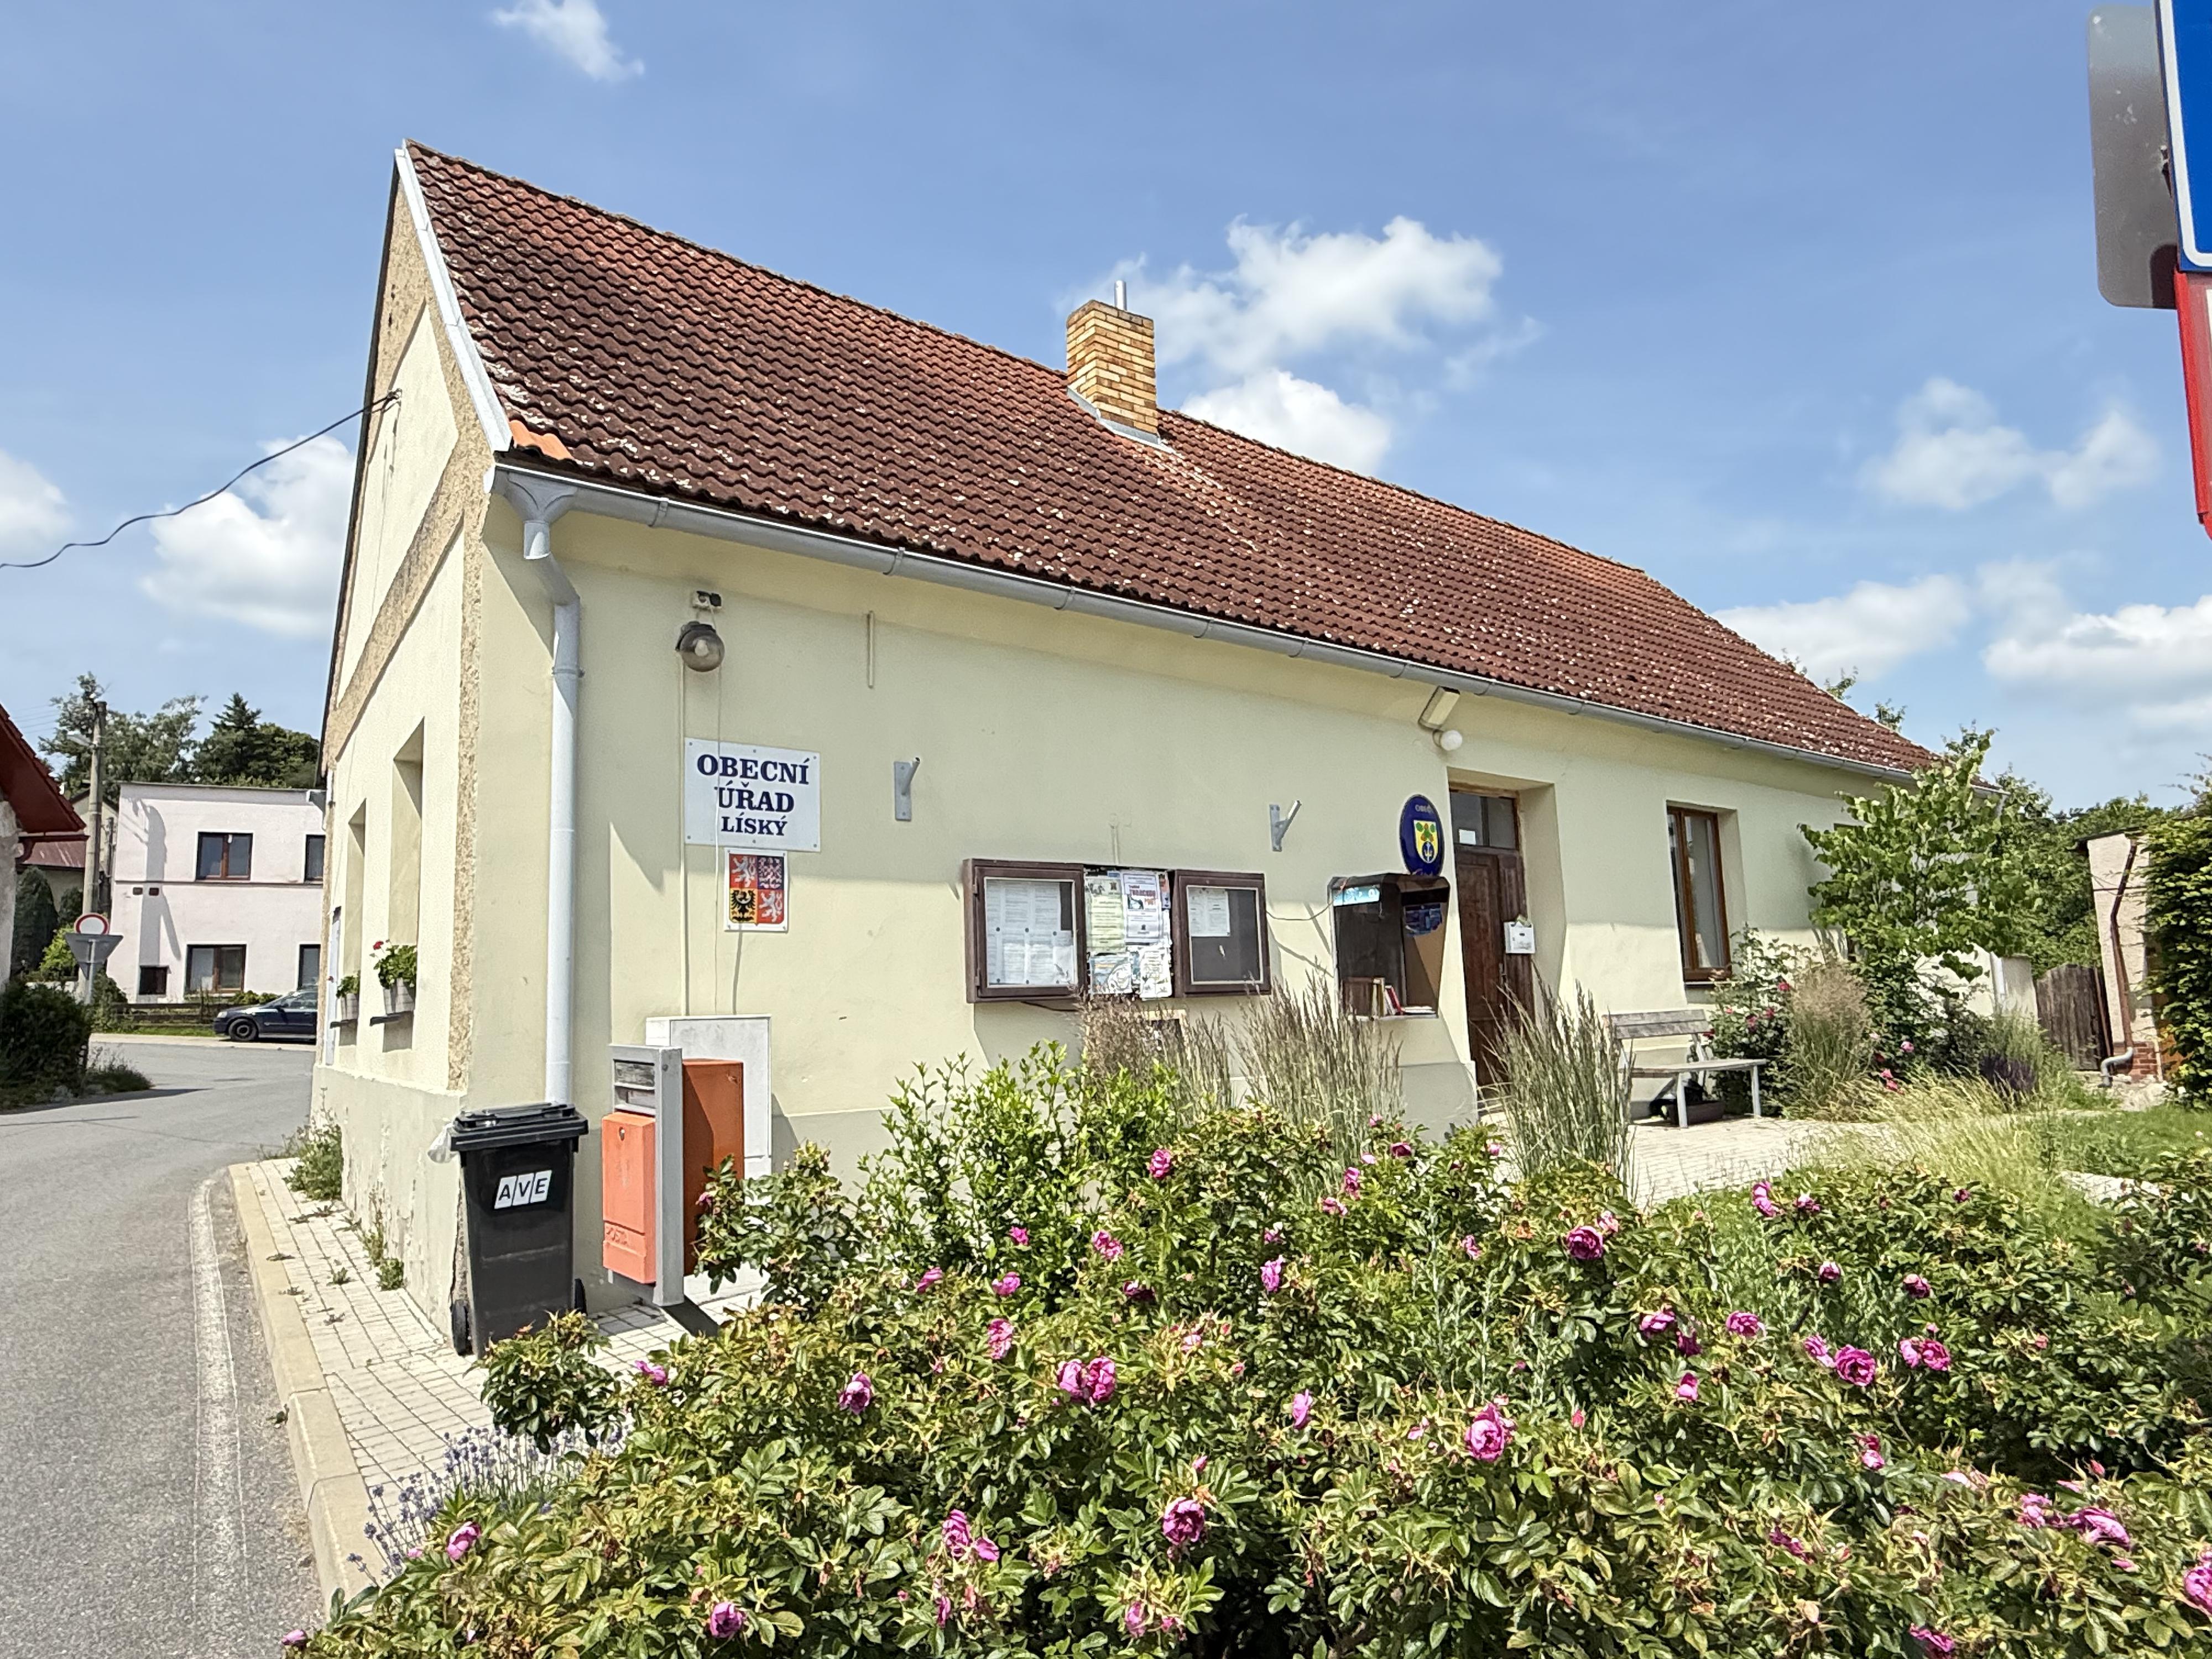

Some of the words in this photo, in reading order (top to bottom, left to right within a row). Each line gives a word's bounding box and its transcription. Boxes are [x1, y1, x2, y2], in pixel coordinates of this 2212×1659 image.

[697, 754, 809, 785] OBECNÍ
[718, 780, 795, 813] ÚŘAD
[721, 812, 787, 836] LÍSKÝ
[499, 1178, 547, 1201] AVE
